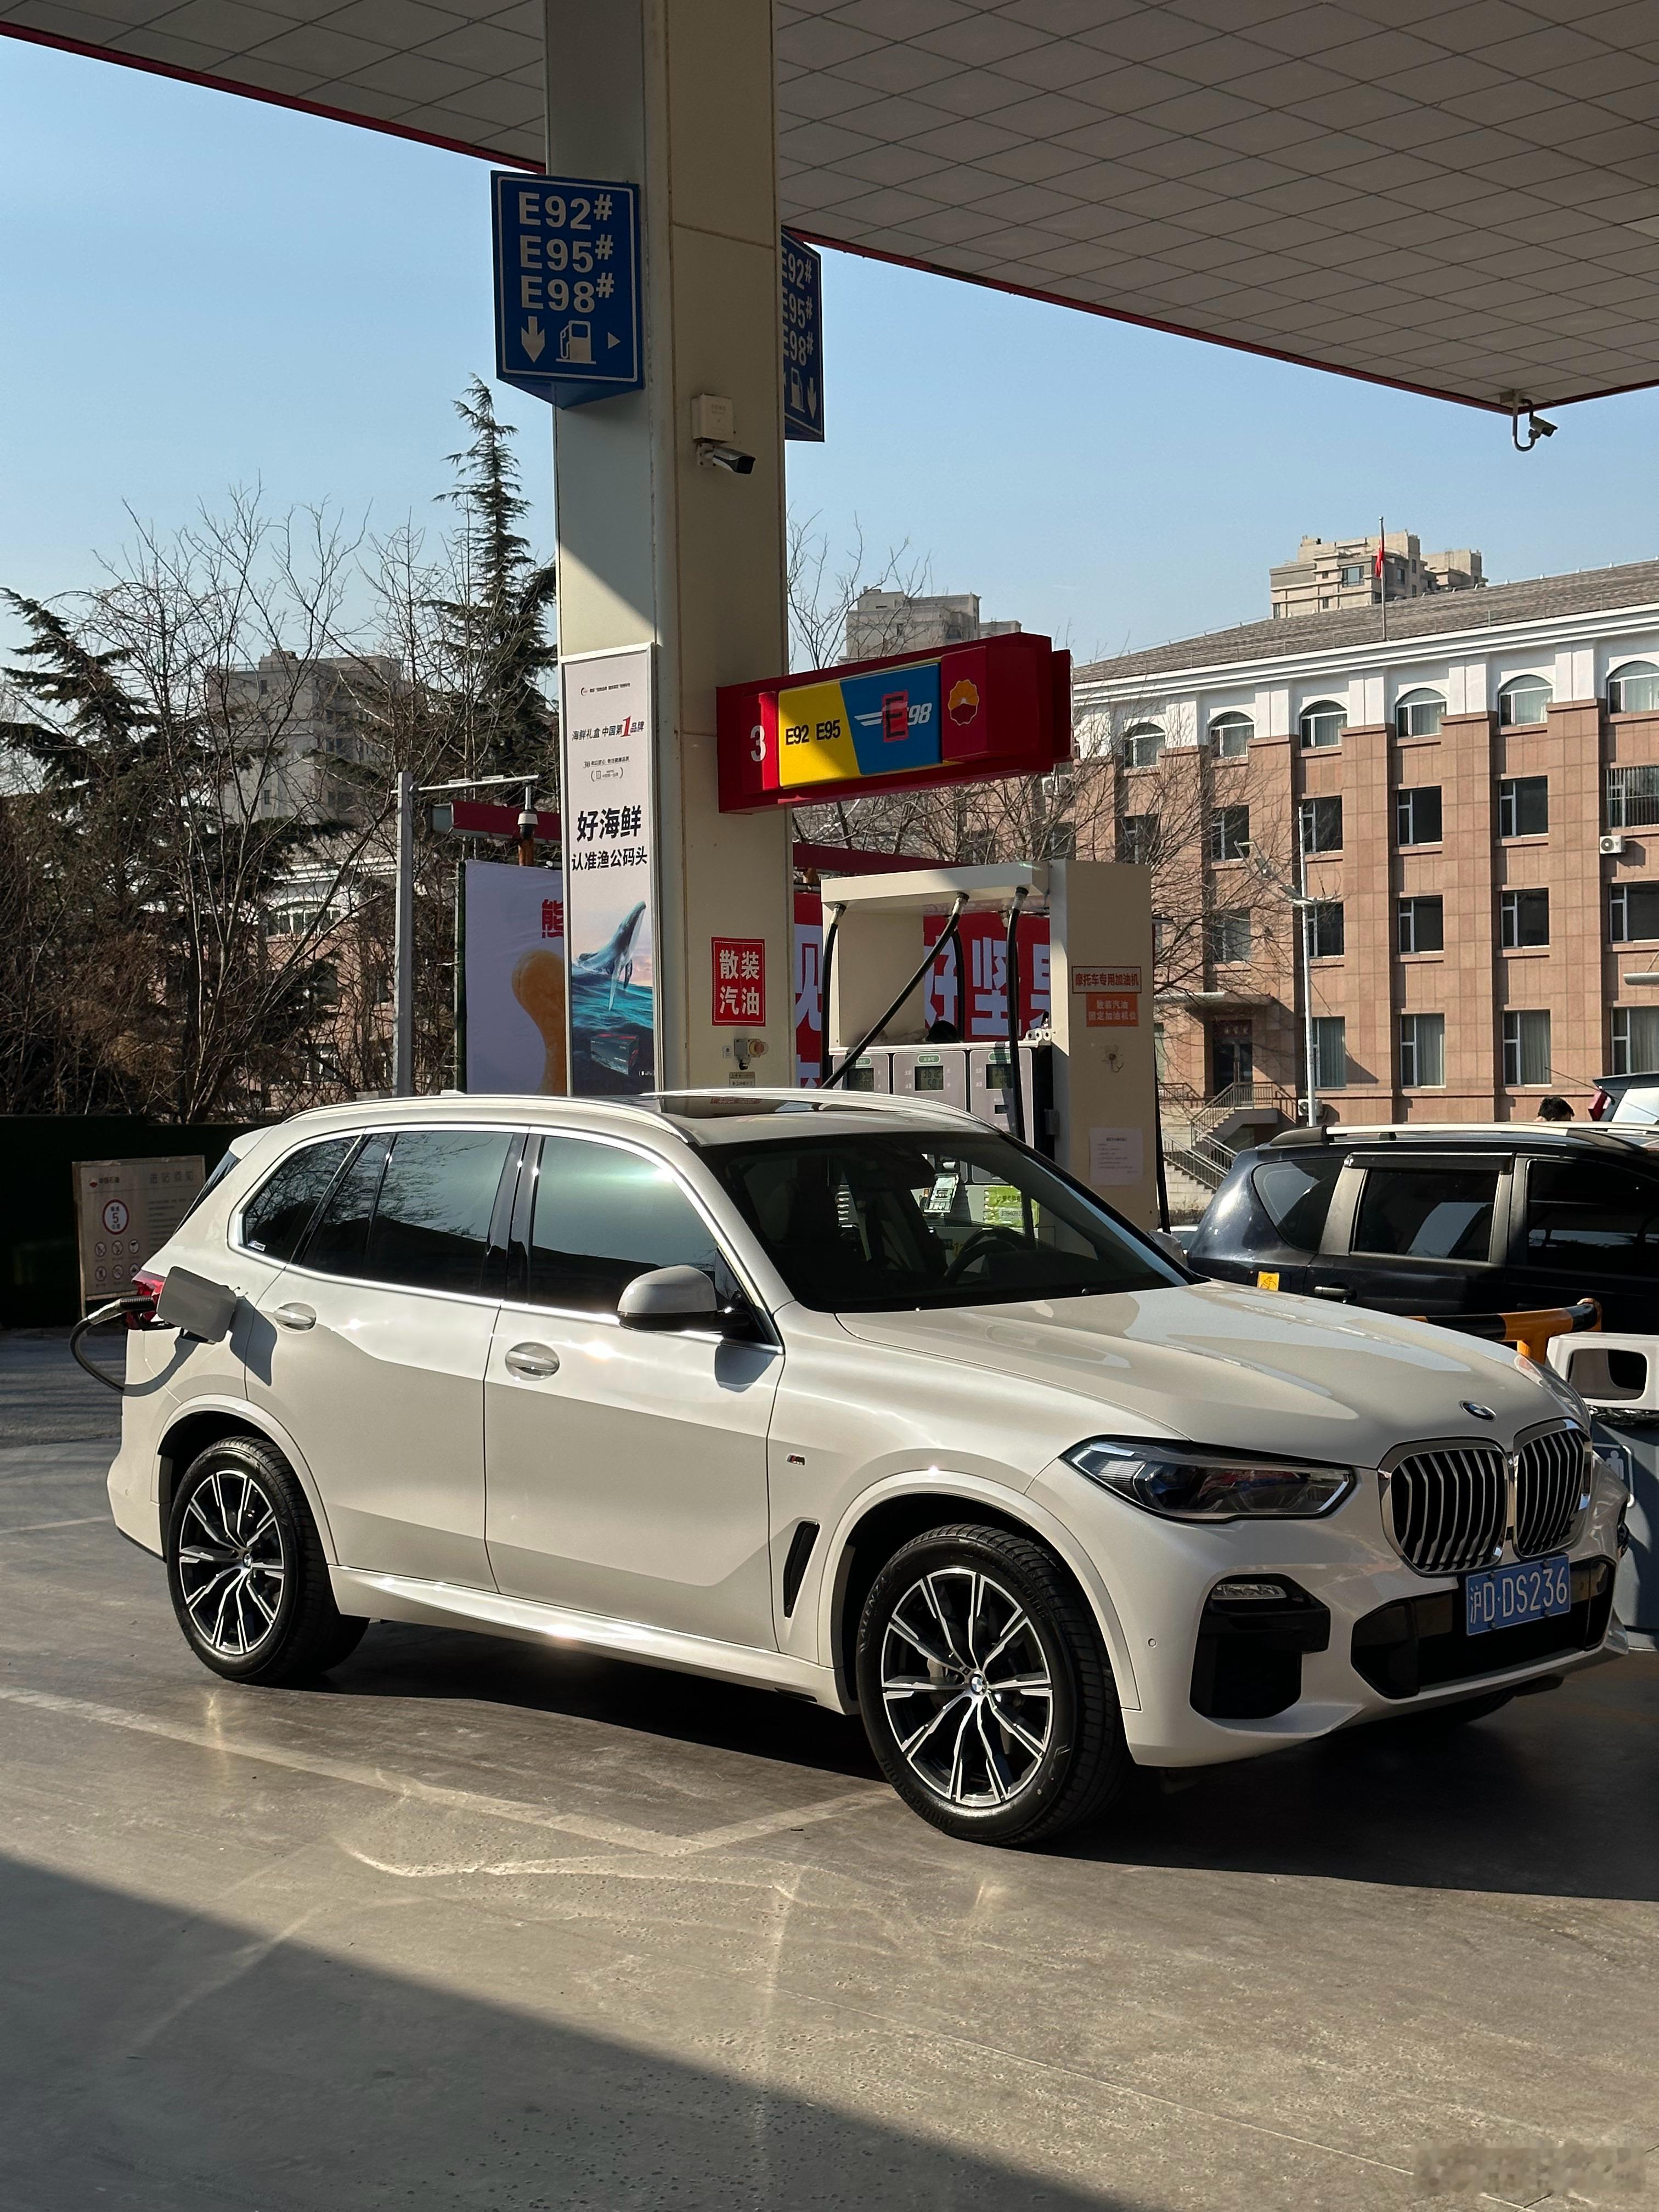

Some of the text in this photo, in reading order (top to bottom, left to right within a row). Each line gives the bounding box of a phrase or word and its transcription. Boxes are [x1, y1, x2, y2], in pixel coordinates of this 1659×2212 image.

[518, 191, 613, 230] E92#
[520, 234, 614, 274] E95#
[521, 272, 614, 313] E98#
[750, 725, 766, 762] 3
[786, 719, 841, 746] E92 E95
[577, 805, 641, 842] 好海鲜
[571, 846, 647, 871] 认准渔公码头
[719, 949, 760, 980] 散装
[1075, 973, 1139, 986] 摩托车专用加油机
[719, 986, 760, 1015] 汽油
[112, 1212, 119, 1223] 5
